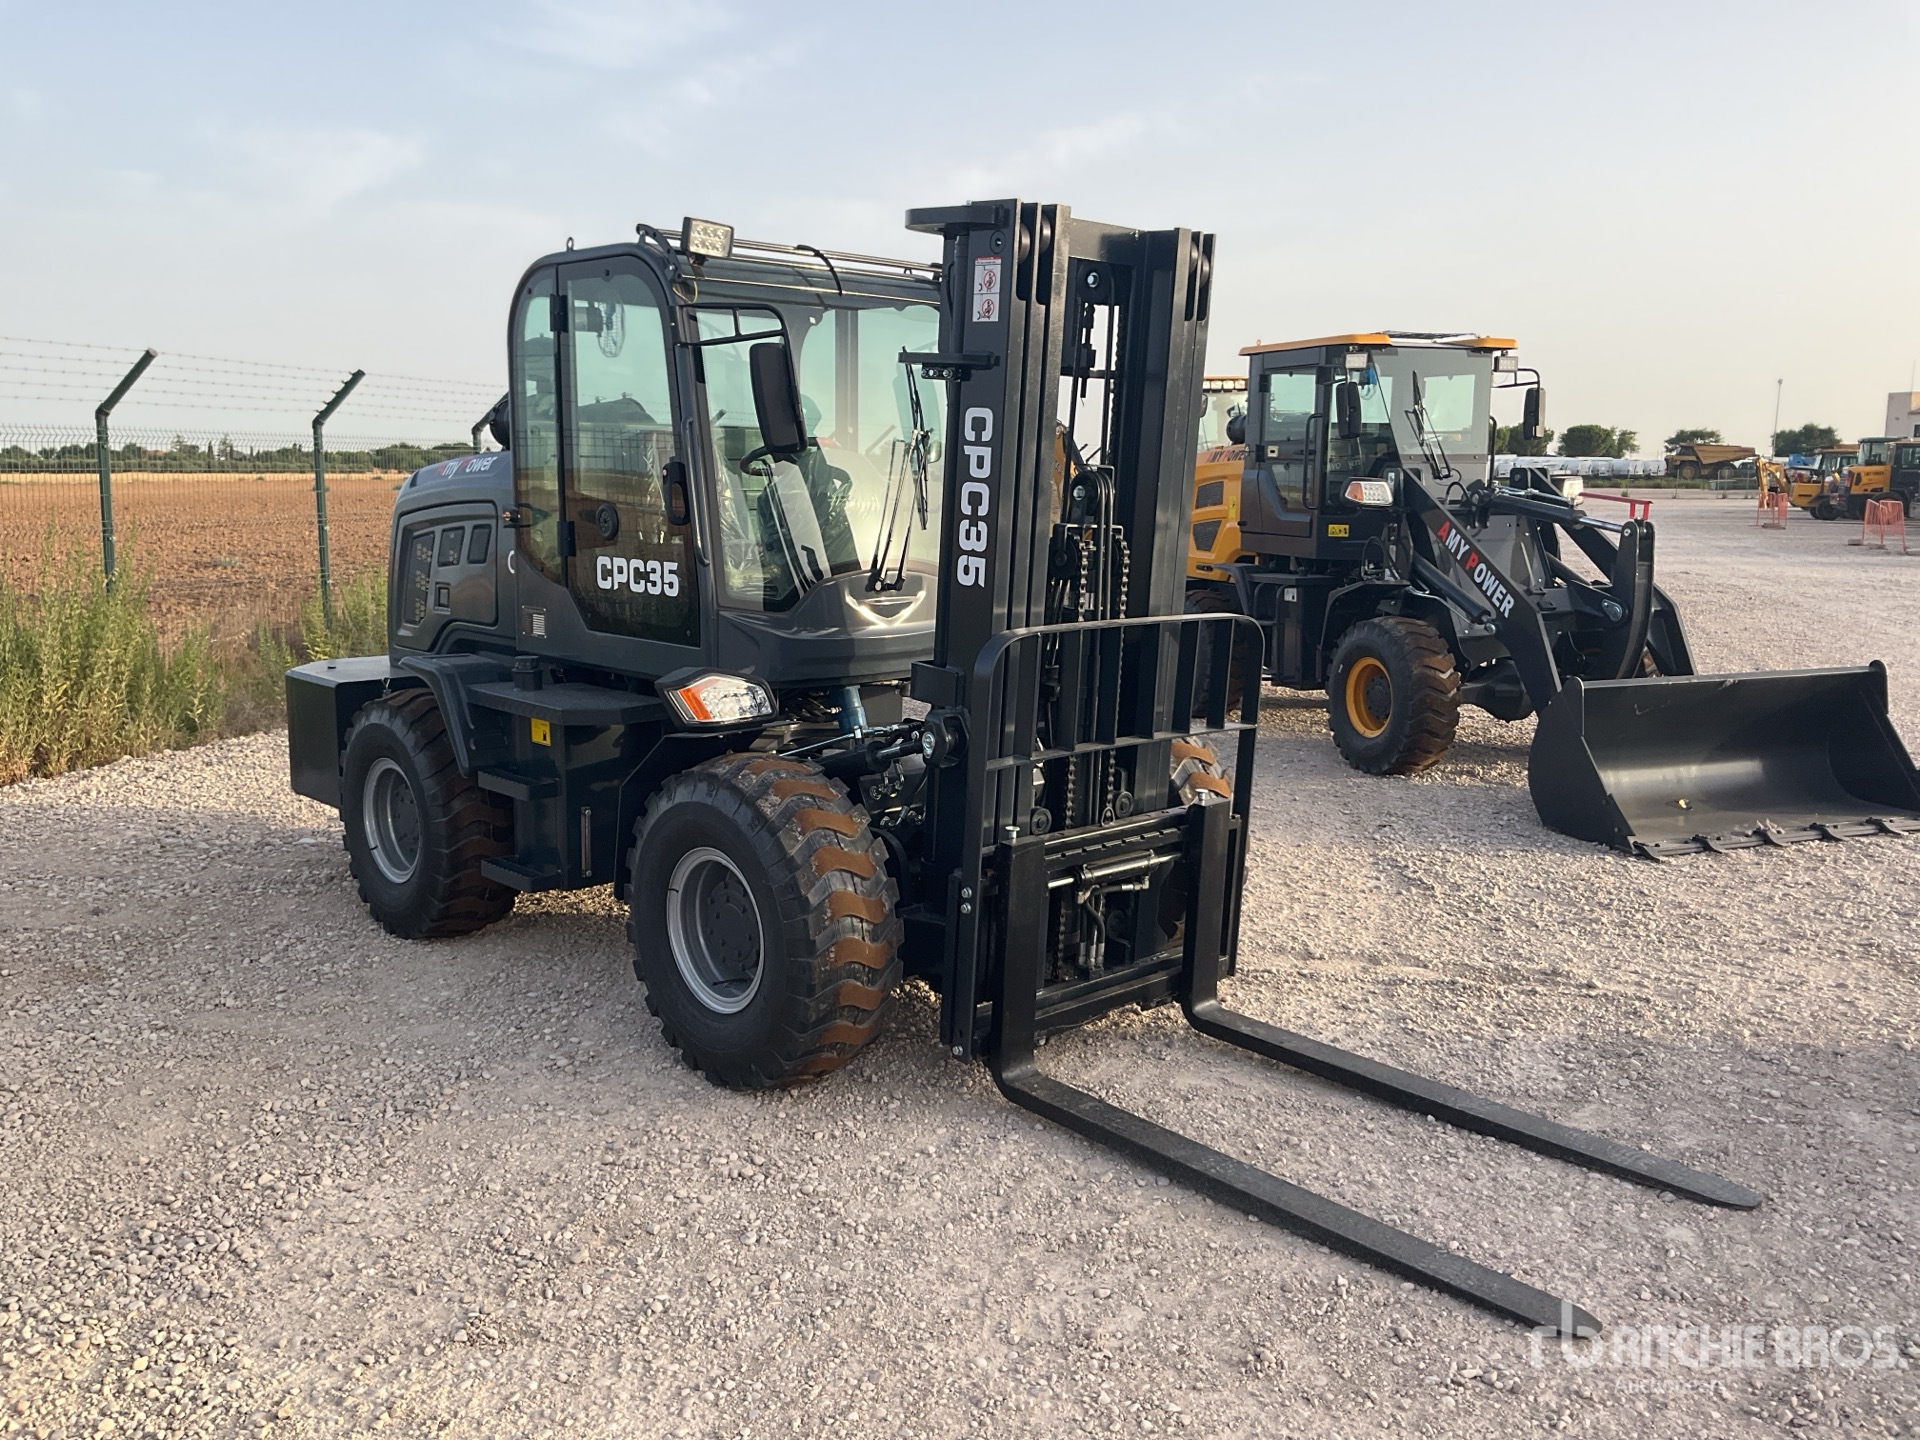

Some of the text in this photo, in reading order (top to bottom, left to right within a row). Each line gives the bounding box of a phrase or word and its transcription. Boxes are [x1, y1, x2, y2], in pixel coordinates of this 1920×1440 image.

[956, 407, 994, 588] CPC35
[596, 556, 680, 597] CPC35
[1437, 521, 1515, 619] AMY POWER
